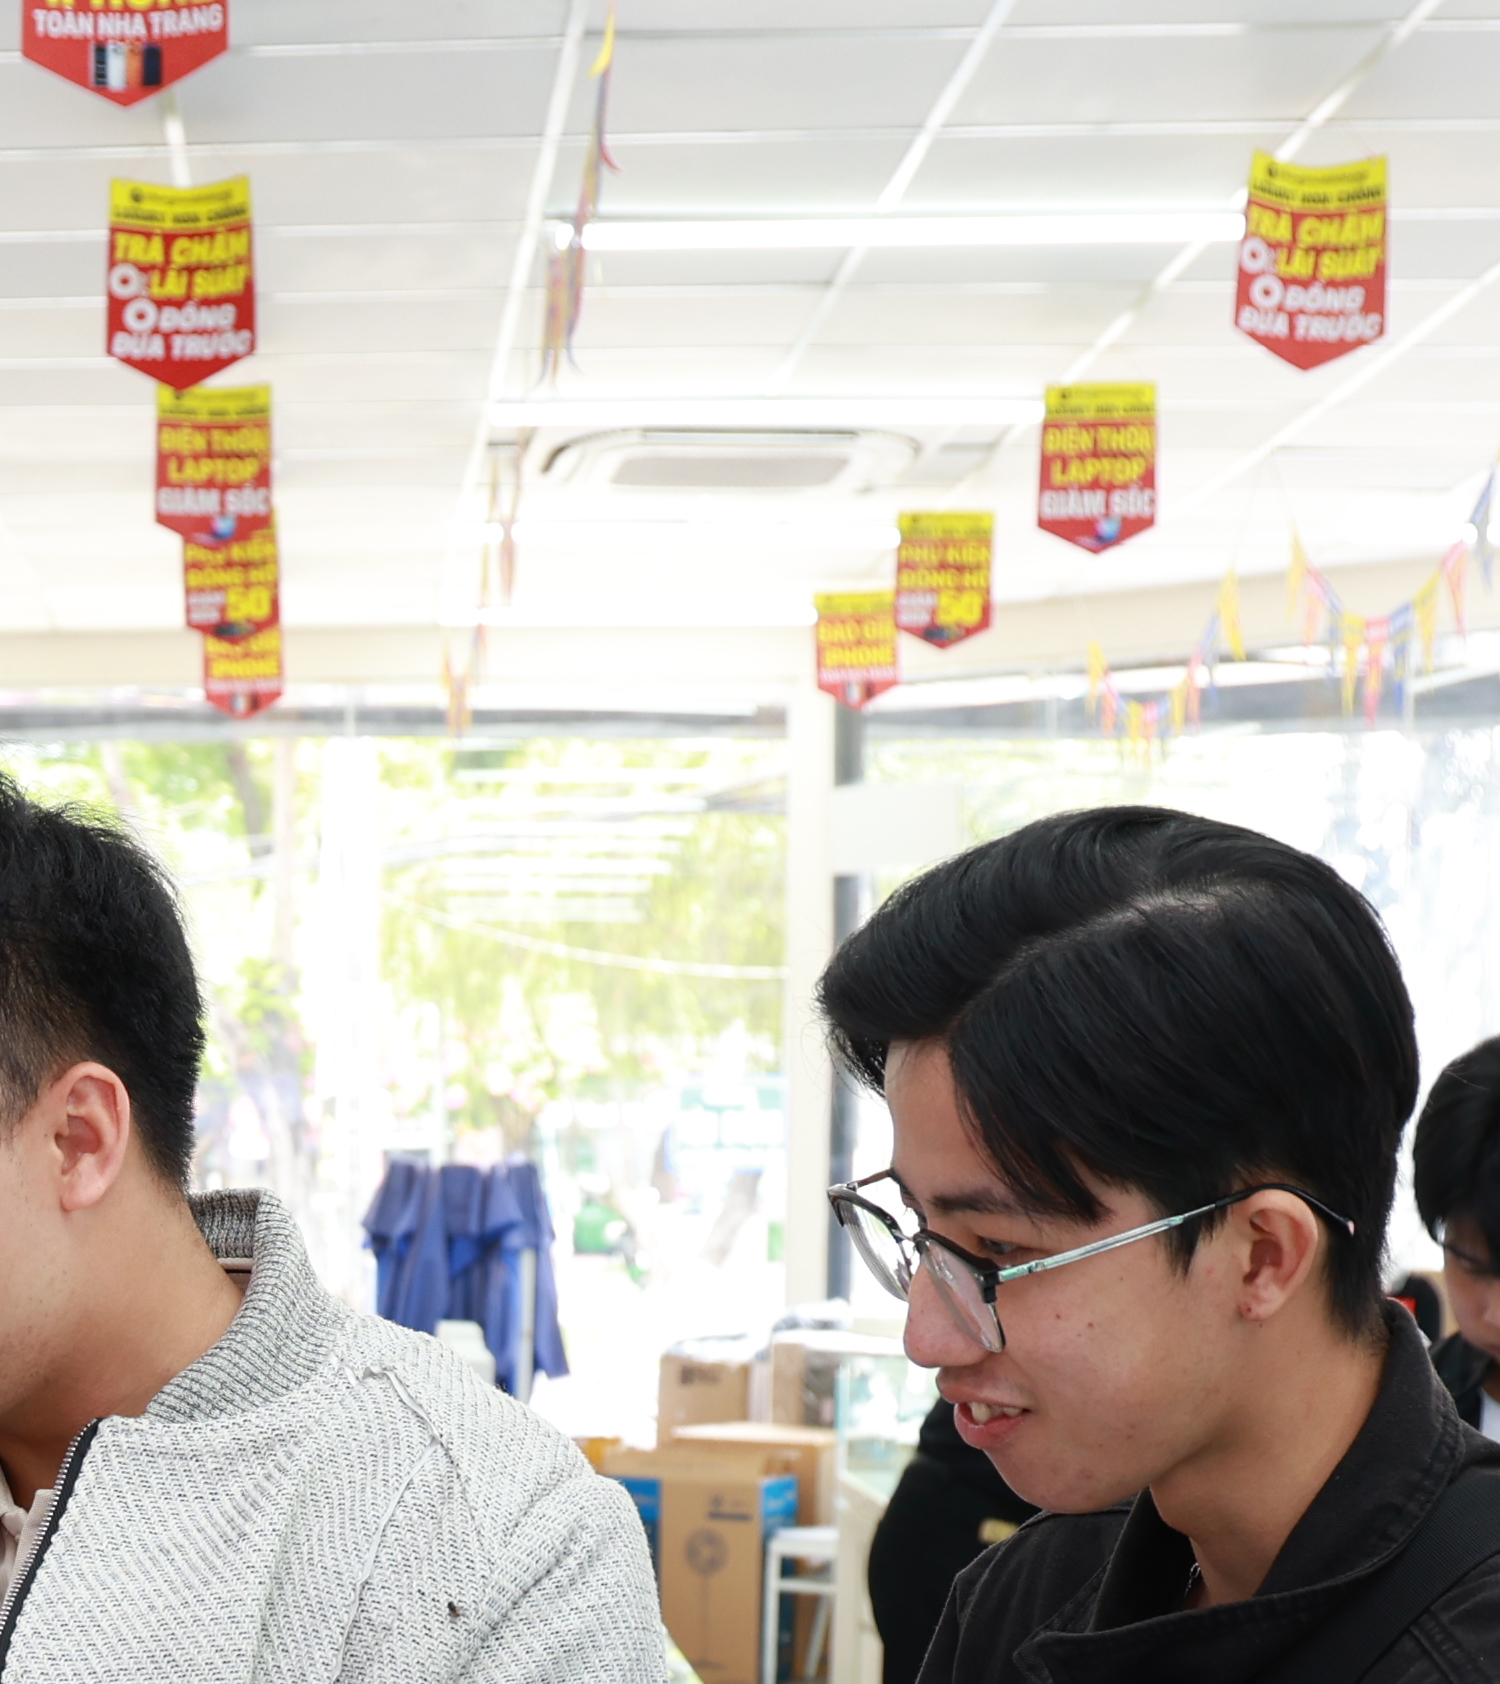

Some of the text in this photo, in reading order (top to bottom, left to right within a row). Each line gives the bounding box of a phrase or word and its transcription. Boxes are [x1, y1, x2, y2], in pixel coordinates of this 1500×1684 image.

[33, 4, 223, 38] TOÀN NHA TRANG
